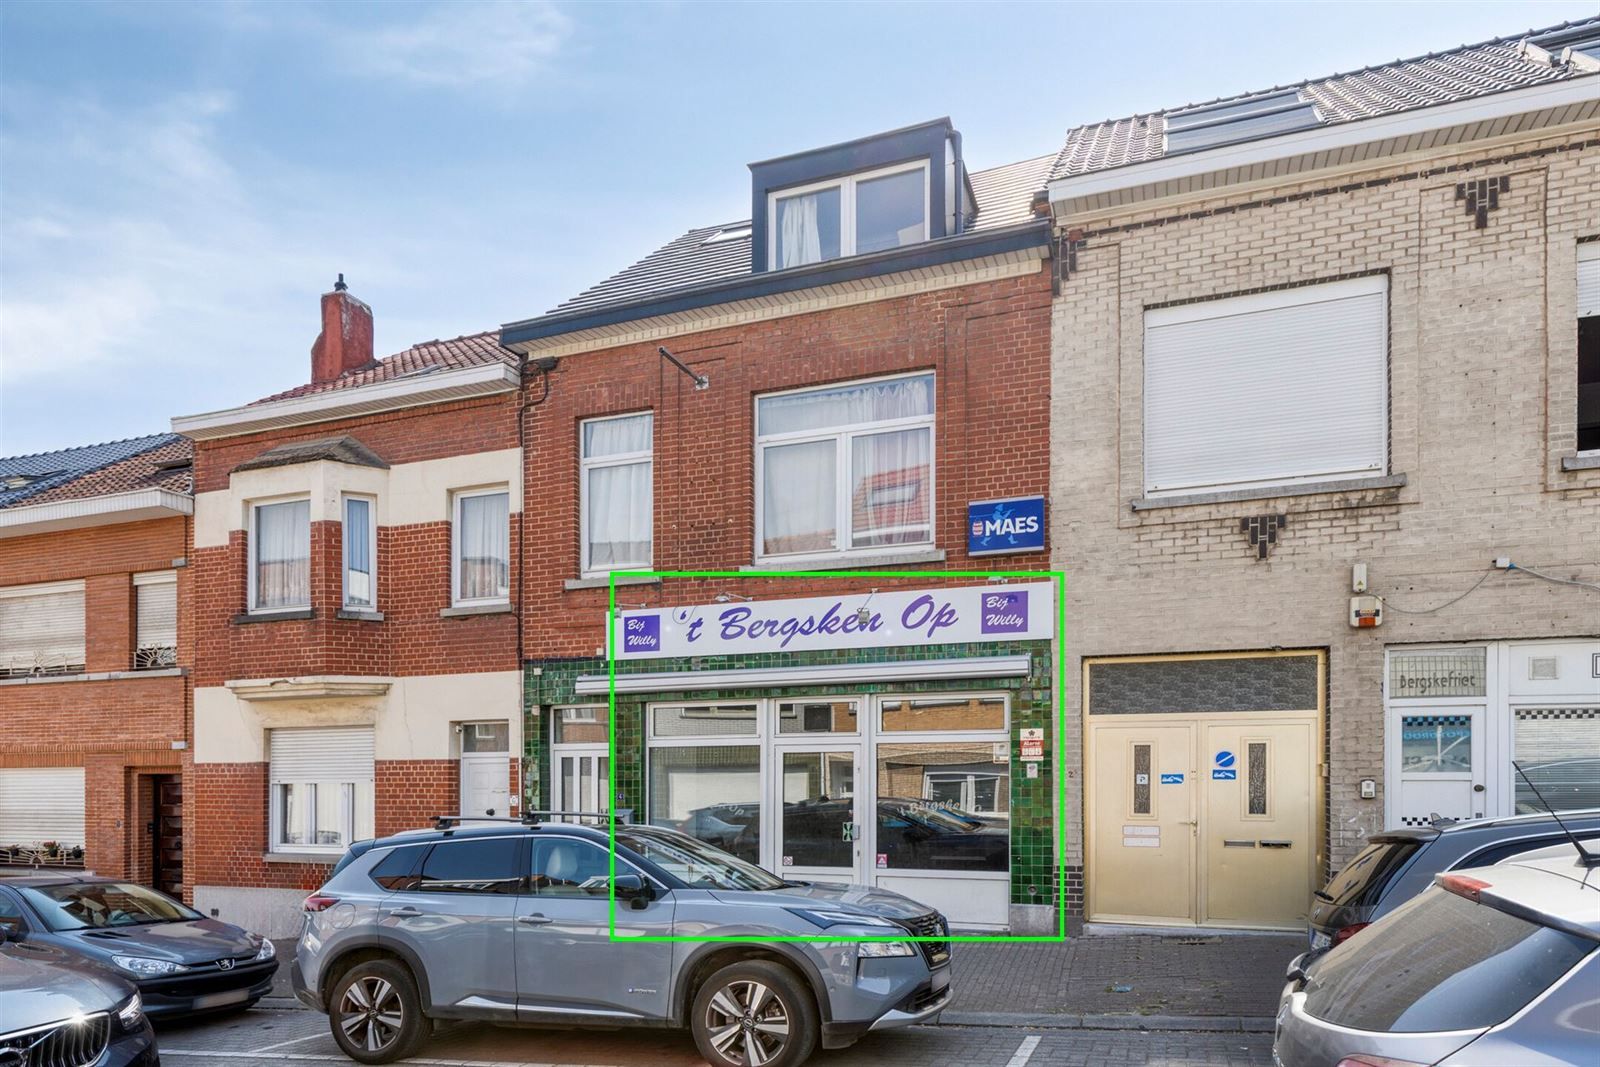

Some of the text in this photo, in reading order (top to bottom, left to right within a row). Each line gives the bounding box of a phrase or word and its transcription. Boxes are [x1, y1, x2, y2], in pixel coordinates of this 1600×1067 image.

[985, 516, 1039, 537] MAES
[986, 596, 1009, 610] Bij
[627, 619, 646, 633] Bij
[718, 601, 884, 648] Bergsken
[901, 594, 959, 638] Op
[985, 613, 1024, 628] Willy
[627, 634, 657, 647] Willy
